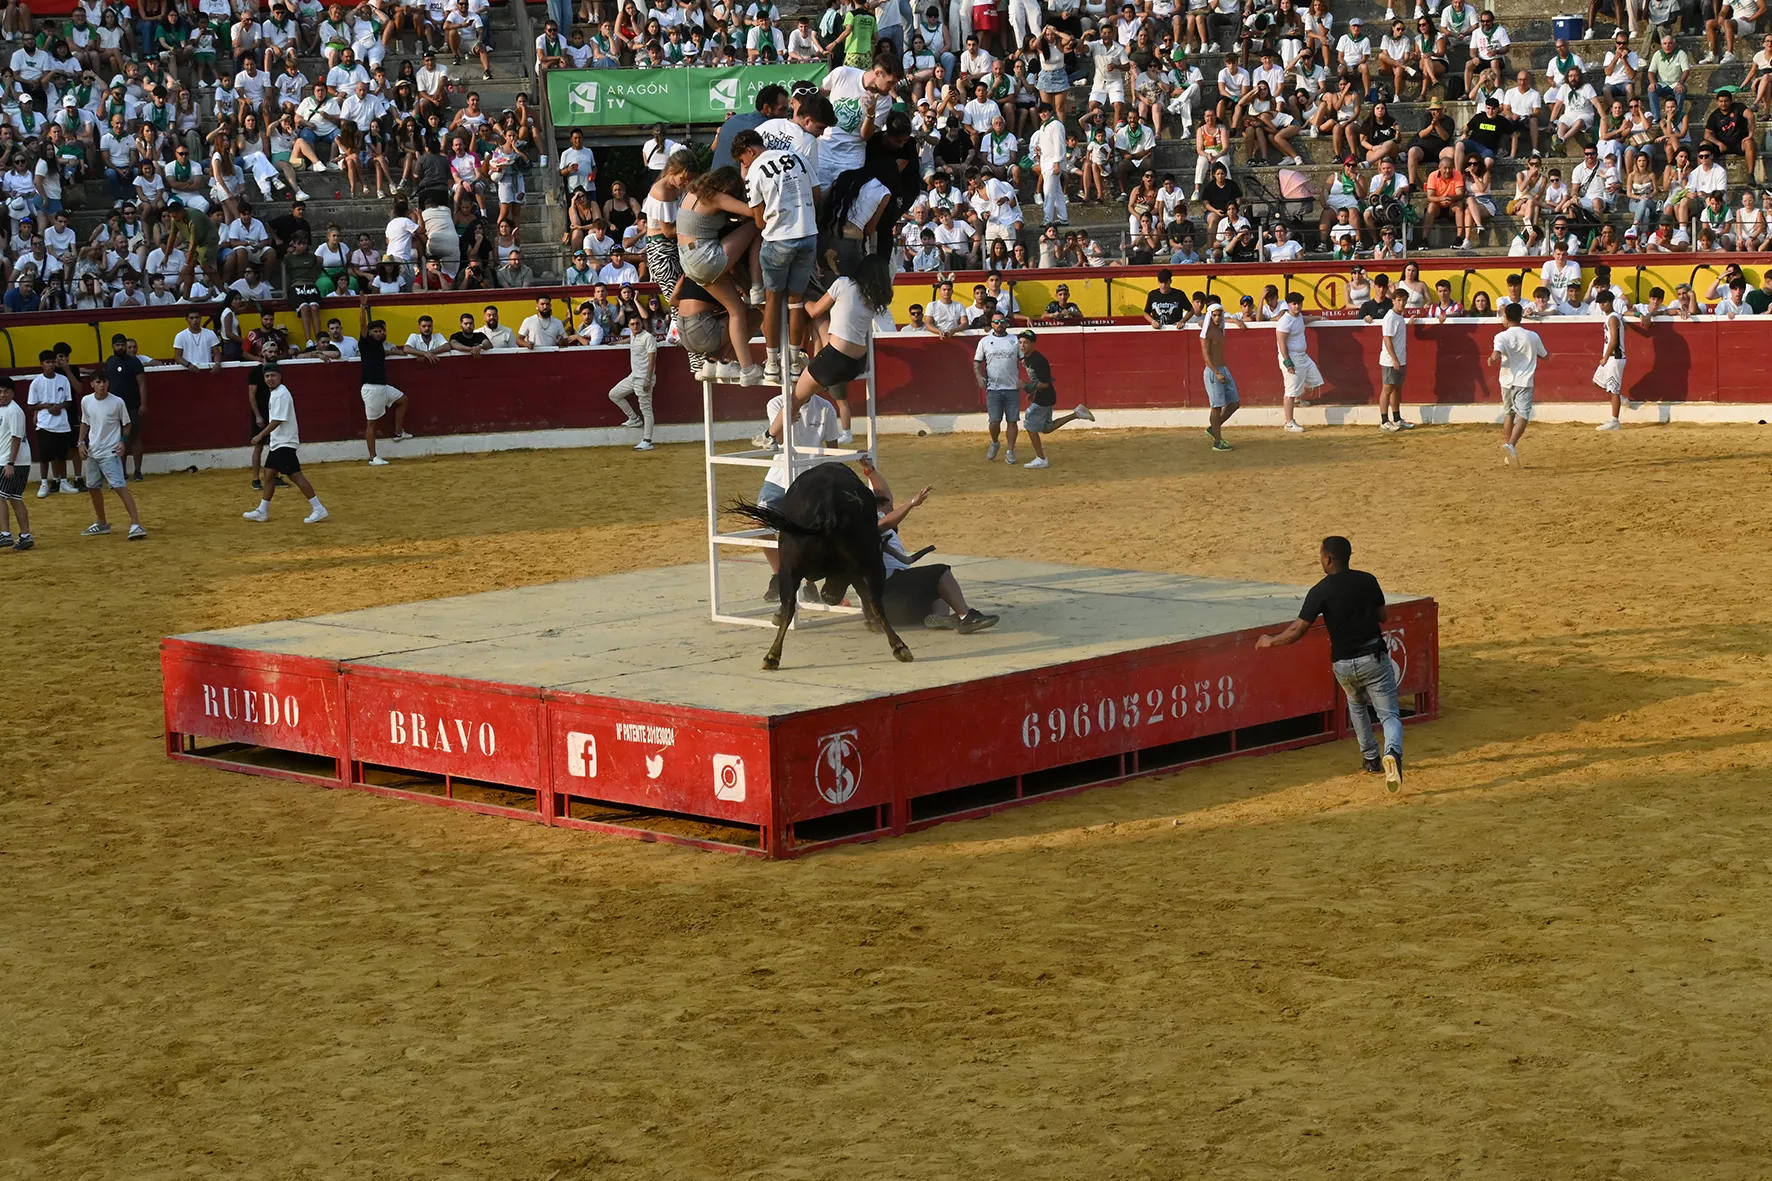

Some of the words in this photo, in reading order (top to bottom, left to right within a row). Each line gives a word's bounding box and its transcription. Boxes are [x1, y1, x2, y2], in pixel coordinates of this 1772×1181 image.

[606, 82, 669, 95] ARAGÓN
[747, 77, 809, 91] ARGÓ
[606, 99, 626, 109] TV
[747, 95, 755, 105] T
[762, 131, 791, 150] NORTH
[779, 130, 794, 144] THE
[1326, 282, 1336, 307] 1
[202, 684, 300, 728] RUEDO
[1022, 675, 1235, 748] 696052858
[389, 710, 496, 757] BRAVO
[623, 724, 646, 743] PATENTE
